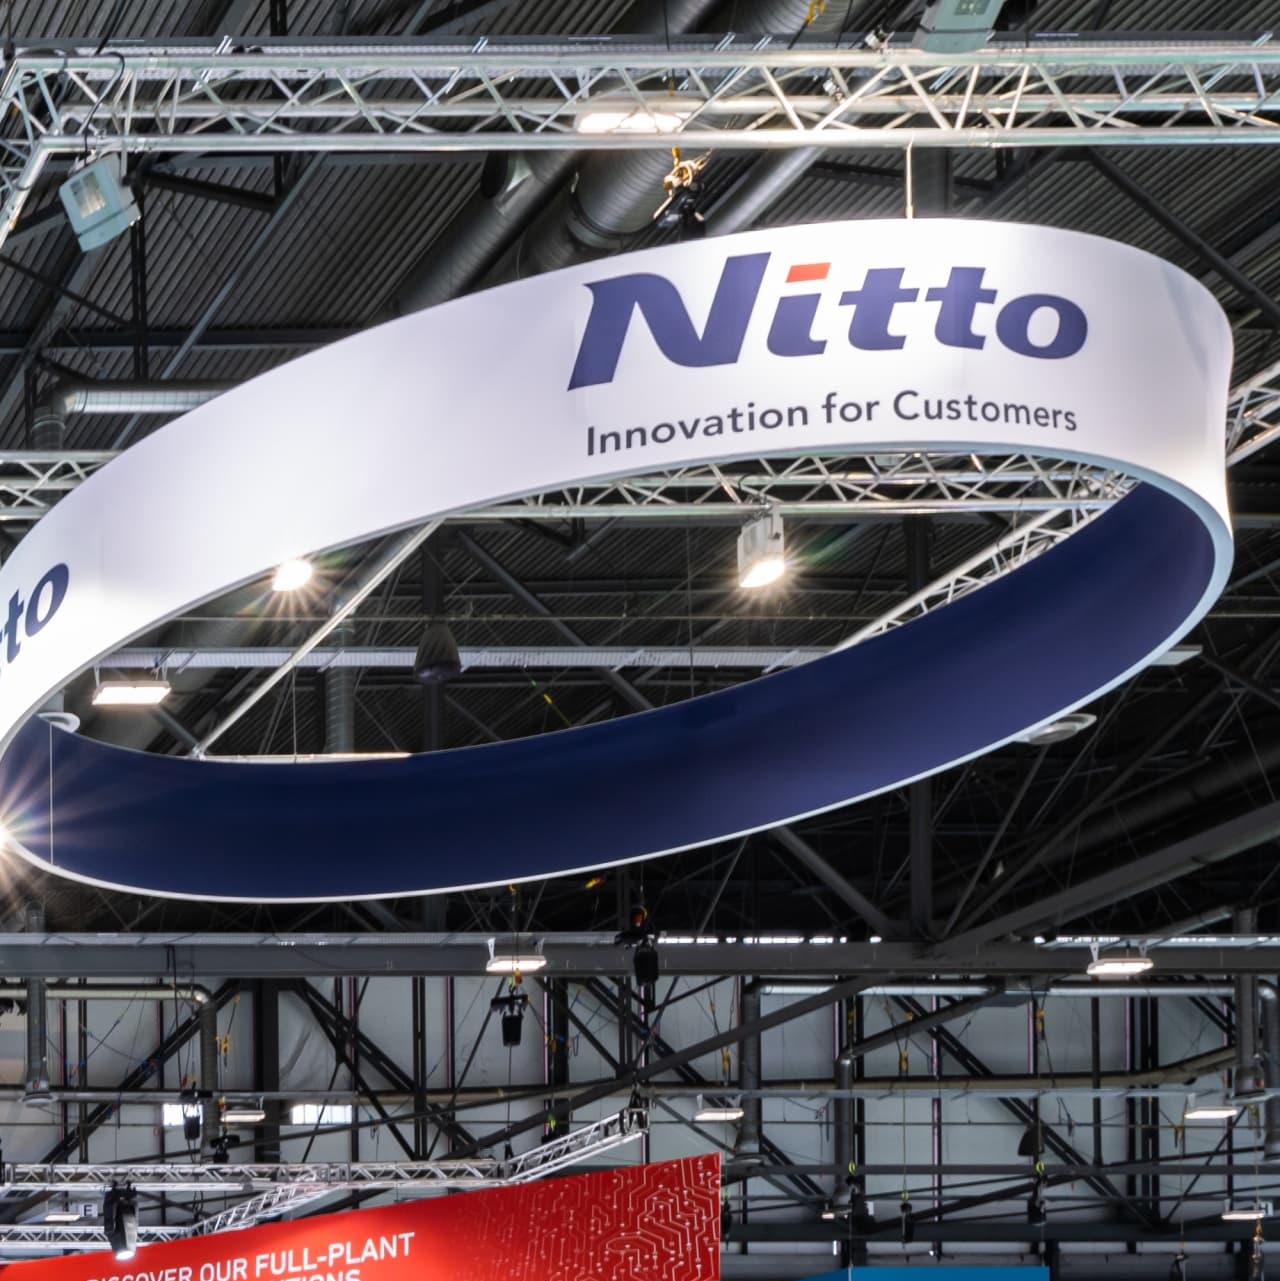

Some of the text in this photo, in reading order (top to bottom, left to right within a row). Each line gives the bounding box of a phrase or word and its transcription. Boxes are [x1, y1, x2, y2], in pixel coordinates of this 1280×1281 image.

[567, 251, 1088, 391] Nitto
[587, 389, 1077, 456] Innovation for Customers
[83, 1204, 93, 1217] E
[254, 1231, 416, 1276] FULL-PLANT
